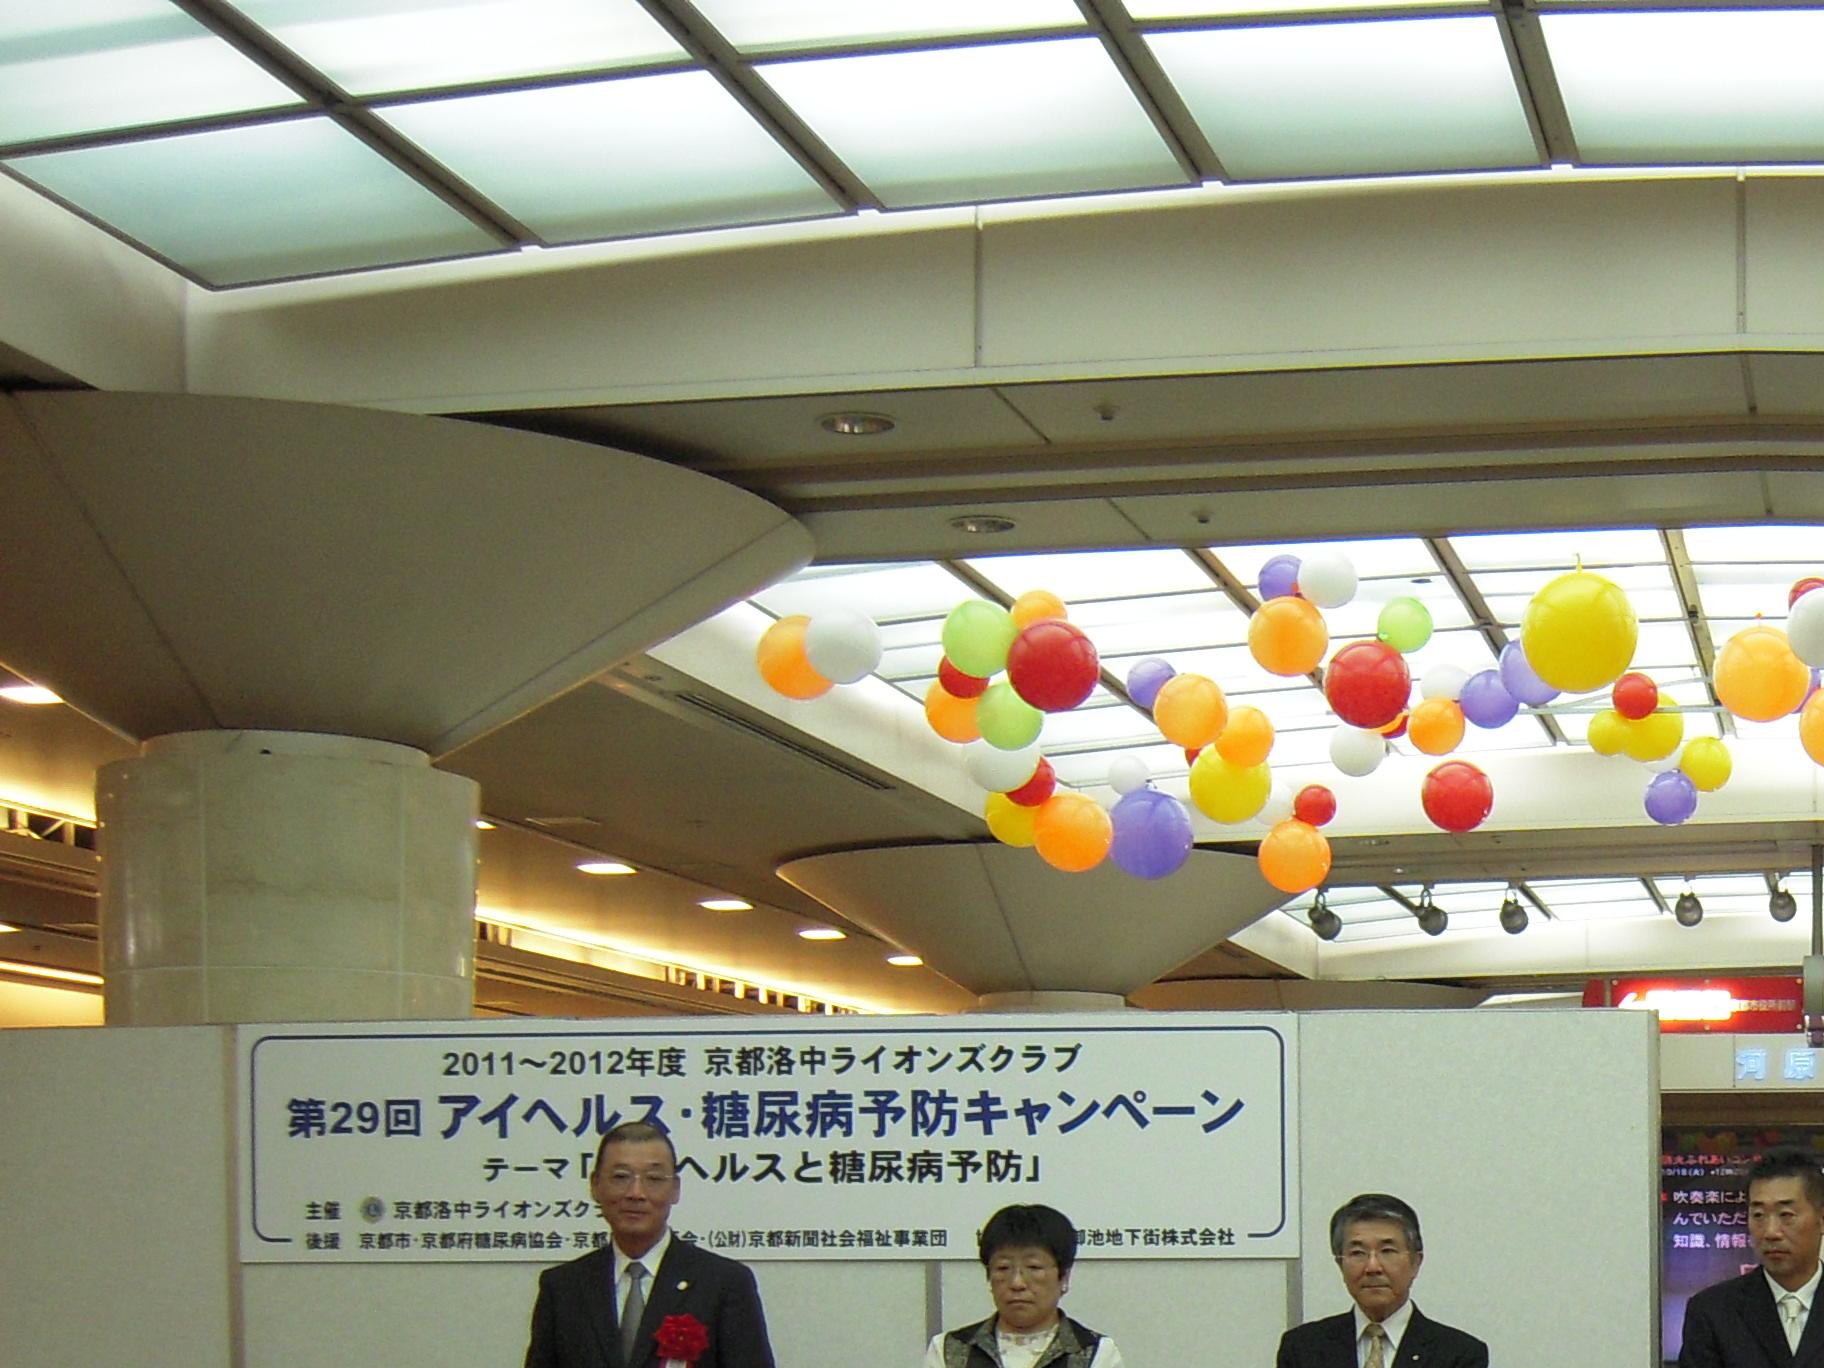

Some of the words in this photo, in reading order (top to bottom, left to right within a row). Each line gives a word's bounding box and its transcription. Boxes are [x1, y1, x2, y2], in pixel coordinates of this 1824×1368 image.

[703, 1043, 1083, 1077] 京都洛中ライオンズクラブ
[286, 1098, 423, 1139] 第29回
[438, 1088, 1246, 1140] アイヘルス・糖尿病予防キャンペーン
[482, 1150, 1042, 1184] テーマ「ヘルスと糖尿病予防」
[306, 1202, 341, 1220] 主催
[393, 1200, 603, 1220] 京都洛中ライオンズク
[306, 1232, 341, 1249] 後援
